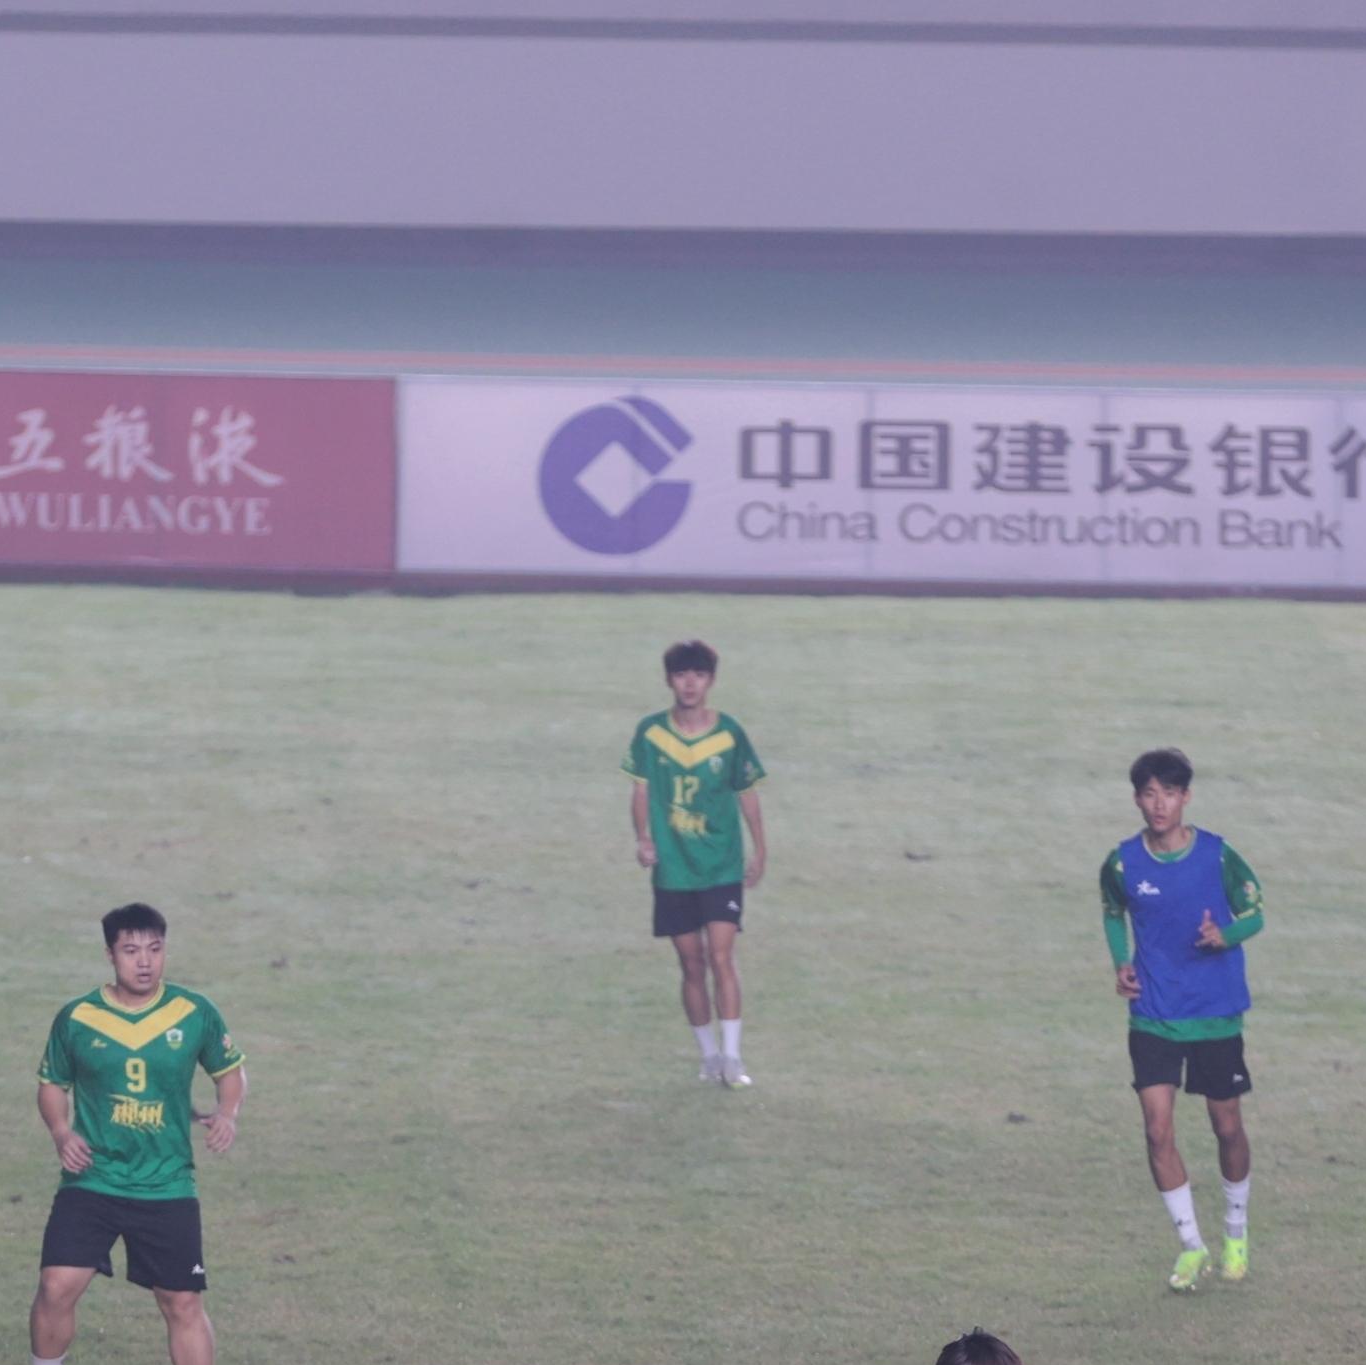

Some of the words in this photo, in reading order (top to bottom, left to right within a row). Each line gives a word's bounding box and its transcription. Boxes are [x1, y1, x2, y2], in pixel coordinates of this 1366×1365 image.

[736, 499, 878, 543] China
[897, 502, 1201, 547] Construction
[1217, 507, 1344, 551] Bank
[125, 1057, 147, 1093] 9
